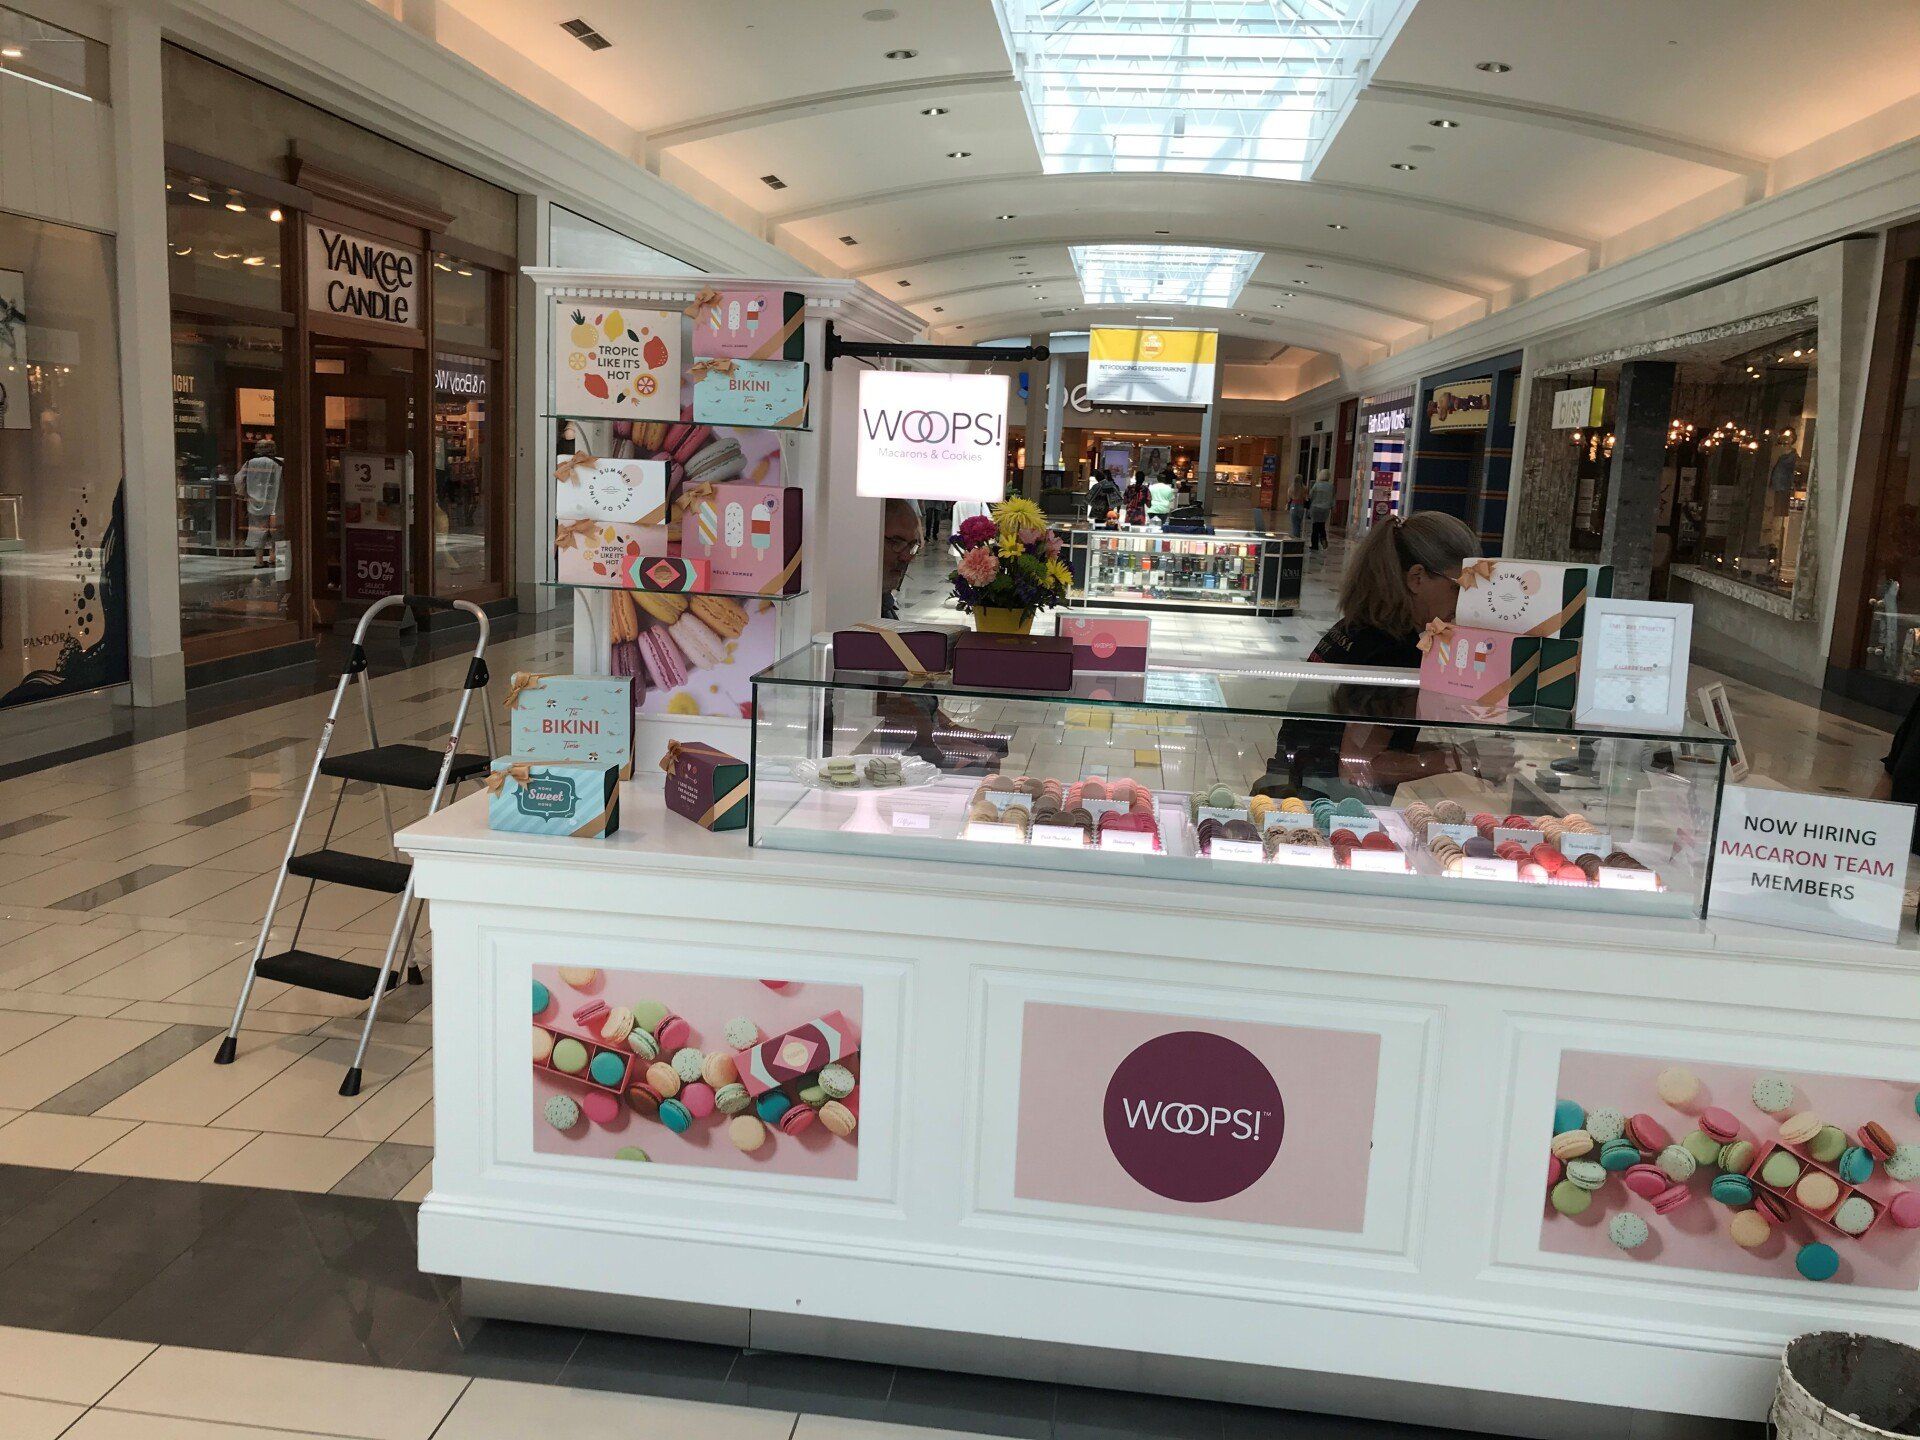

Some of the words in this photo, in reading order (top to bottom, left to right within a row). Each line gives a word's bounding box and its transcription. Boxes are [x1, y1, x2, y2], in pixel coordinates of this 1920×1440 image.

[598, 345, 639, 357] TROPIC
[597, 358, 621, 368] LIKE
[623, 359, 640, 369] IT'S
[607, 370, 631, 381] HOT
[729, 379, 771, 392] BIKINI
[863, 408, 1002, 447] WOOPS!
[878, 447, 928, 459] Macarons
[930, 450, 939, 460] &
[941, 450, 982, 462] Cookies
[354, 463, 372, 483] $3
[599, 467, 631, 484] SUMMER
[588, 484, 600, 506] MIND
[617, 487, 634, 511] STATE
[357, 559, 395, 579] 50%
[1499, 573, 1529, 591] SUMMER
[1487, 590, 1497, 613] MIND
[1512, 595, 1530, 620] STATE
[541, 718, 600, 735] BIKINI
[562, 740, 580, 750] Time
[528, 786, 565, 803] Sweet
[1744, 815, 1798, 836] NOW
[1803, 822, 1878, 846] HIRING
[1720, 840, 1828, 869] MACARON
[1834, 855, 1895, 877] TEAM
[1751, 872, 1856, 901] MEMBERS
[1122, 1097, 1261, 1141] WOOPS!
